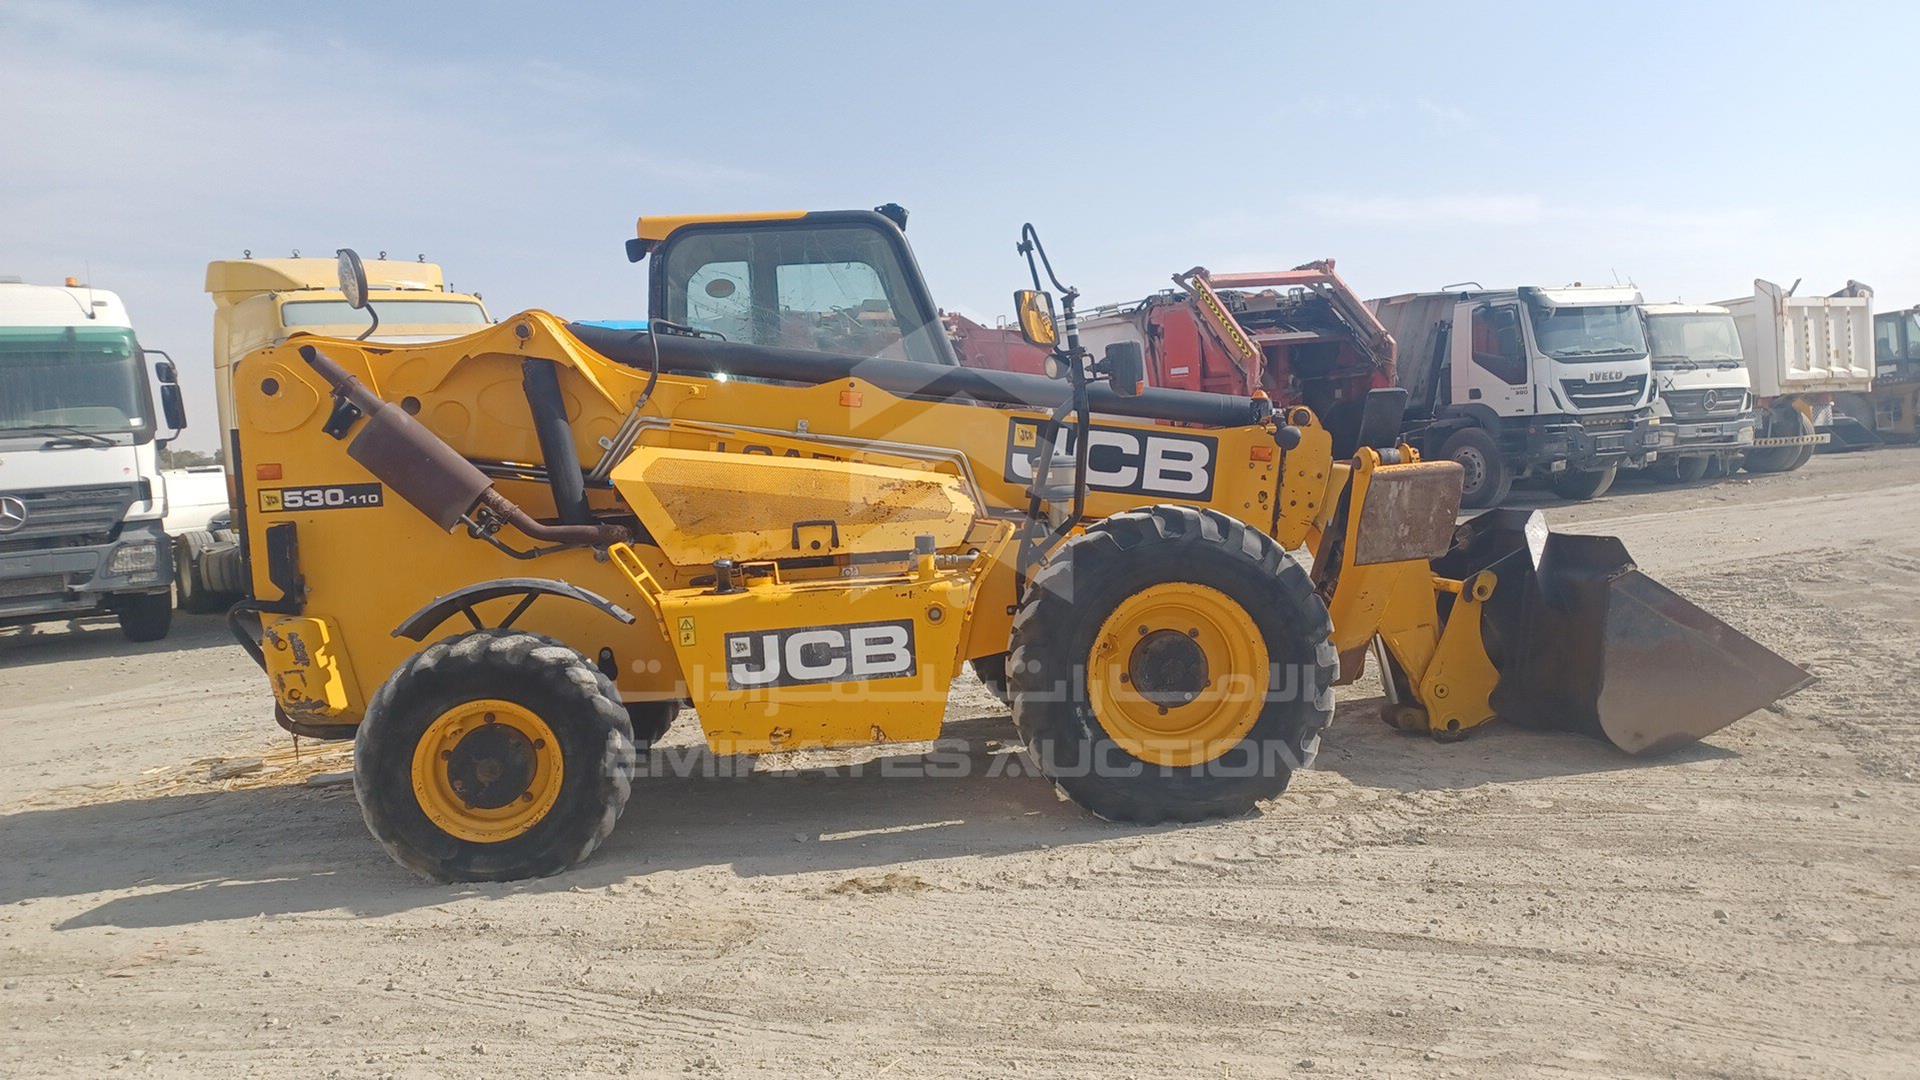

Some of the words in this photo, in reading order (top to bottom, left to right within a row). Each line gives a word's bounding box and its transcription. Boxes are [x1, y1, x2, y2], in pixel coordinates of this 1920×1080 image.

[1589, 371, 1623, 382] IVECO
[283, 488, 379, 508] 530-110
[731, 625, 912, 685] JCB
